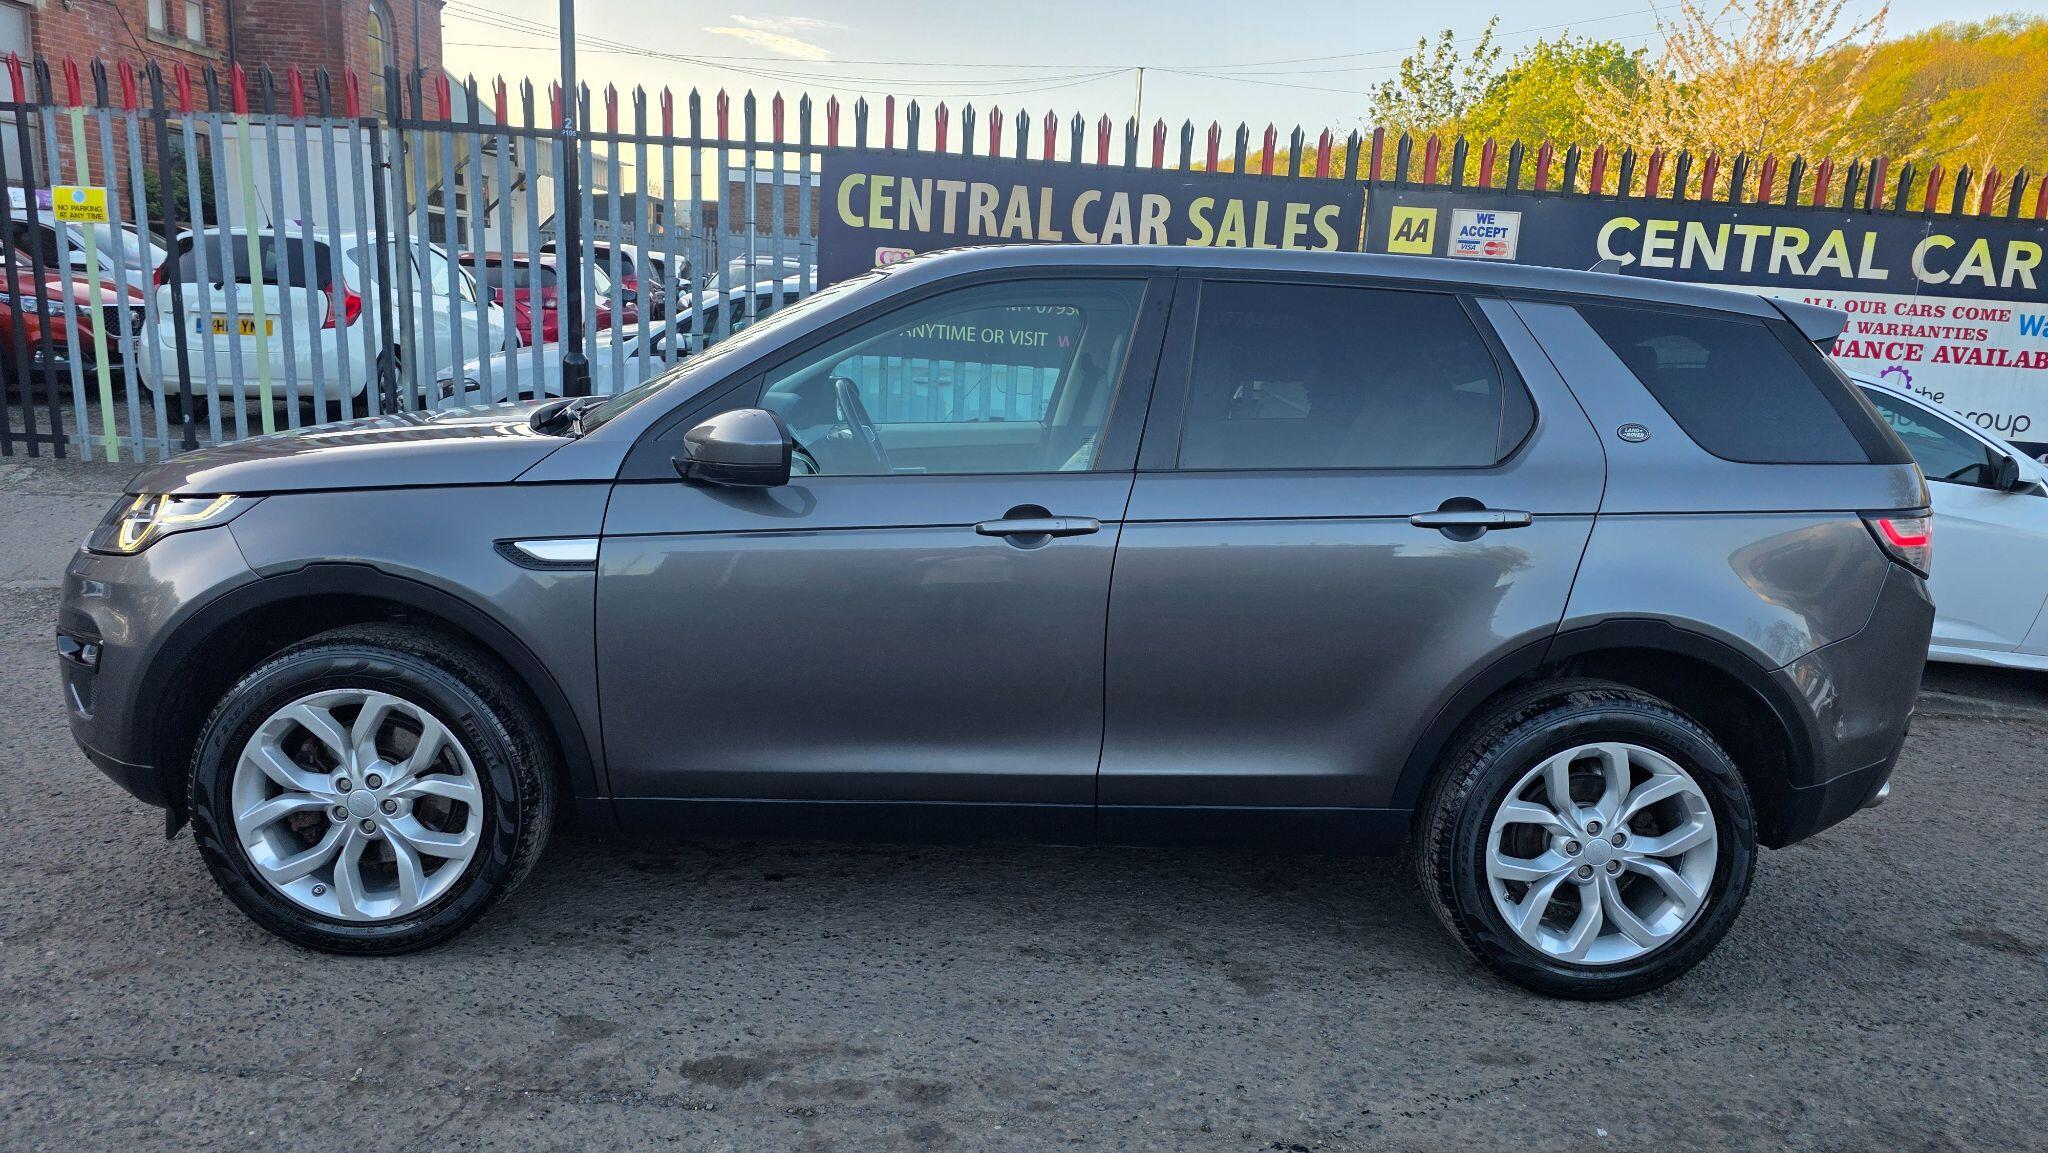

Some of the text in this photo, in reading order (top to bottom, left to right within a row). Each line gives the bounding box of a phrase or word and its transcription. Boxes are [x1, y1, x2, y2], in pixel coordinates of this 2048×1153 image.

[564, 117, 572, 129] 2
[70, 205, 103, 213] PARKING
[837, 173, 1341, 251] CENTRAL CAR SALES
[1476, 213, 1495, 224] WE
[1393, 217, 1430, 243] AA
[1460, 226, 1508, 239] ACCEPT
[1596, 216, 2043, 290] CENTRAL CAR
[1844, 300, 1887, 314] OUR
[1894, 302, 1946, 319] CARS
[1952, 306, 2012, 323] COME
[981, 328, 1004, 344] OR
[1009, 330, 1049, 347] VISIT
[1857, 321, 1989, 341] WARRANTIES
[1830, 339, 2048, 369] NANCE AVAILAB
[1953, 411, 2031, 437] roup
